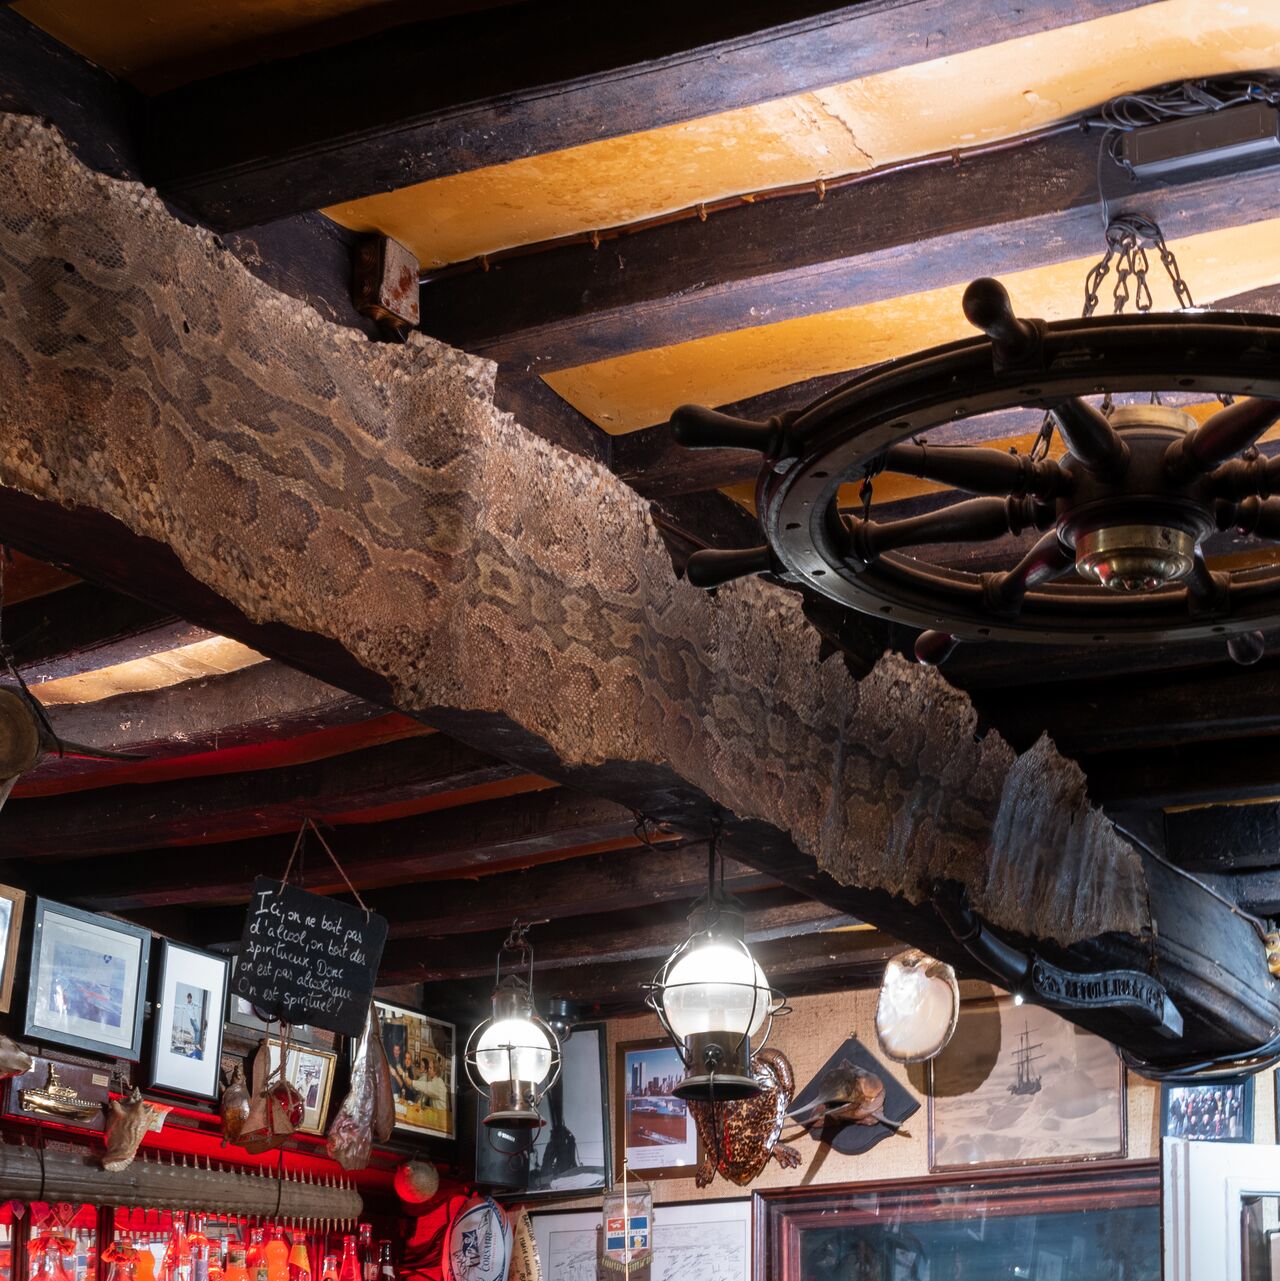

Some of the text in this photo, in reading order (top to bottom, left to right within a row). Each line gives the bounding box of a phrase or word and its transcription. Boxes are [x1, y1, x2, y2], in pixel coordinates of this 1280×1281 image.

[287, 911, 301, 924] on
[304, 915, 317, 928] ne
[321, 912, 343, 936] boit
[343, 929, 363, 947] pas
[310, 939, 324, 951] on
[328, 939, 350, 961] boit
[350, 948, 366, 966] des
[240, 960, 254, 973] on
[256, 962, 272, 977] est
[274, 967, 293, 984] pas
[316, 959, 345, 980] Donc
[238, 976, 257, 997] On
[262, 986, 280, 1001] est
[481, 1231, 493, 1272] CORSAIRE
